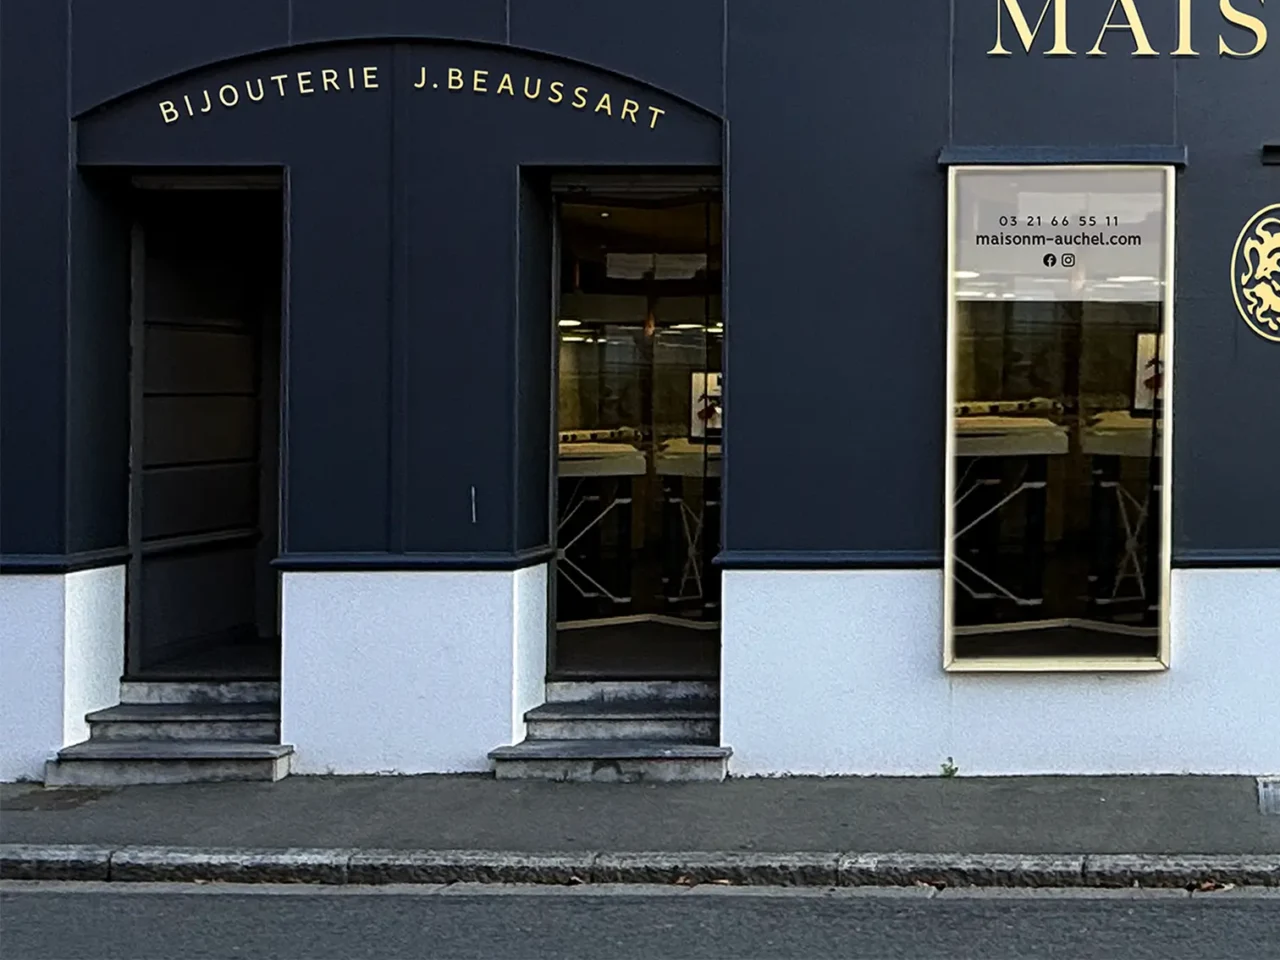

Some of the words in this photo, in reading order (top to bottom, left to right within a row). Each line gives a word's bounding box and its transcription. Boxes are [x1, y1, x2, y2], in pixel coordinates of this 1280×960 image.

[158, 66, 380, 124] BIJOUTERIE
[413, 66, 666, 130] J.BEAUSSART
[999, 215, 1018, 227] 03
[1026, 215, 1042, 227] 21
[1050, 215, 1069, 227] 66
[1079, 215, 1097, 227] 55
[1105, 215, 1119, 227] 11
[976, 231, 1142, 246] maisonm-auchel.com
